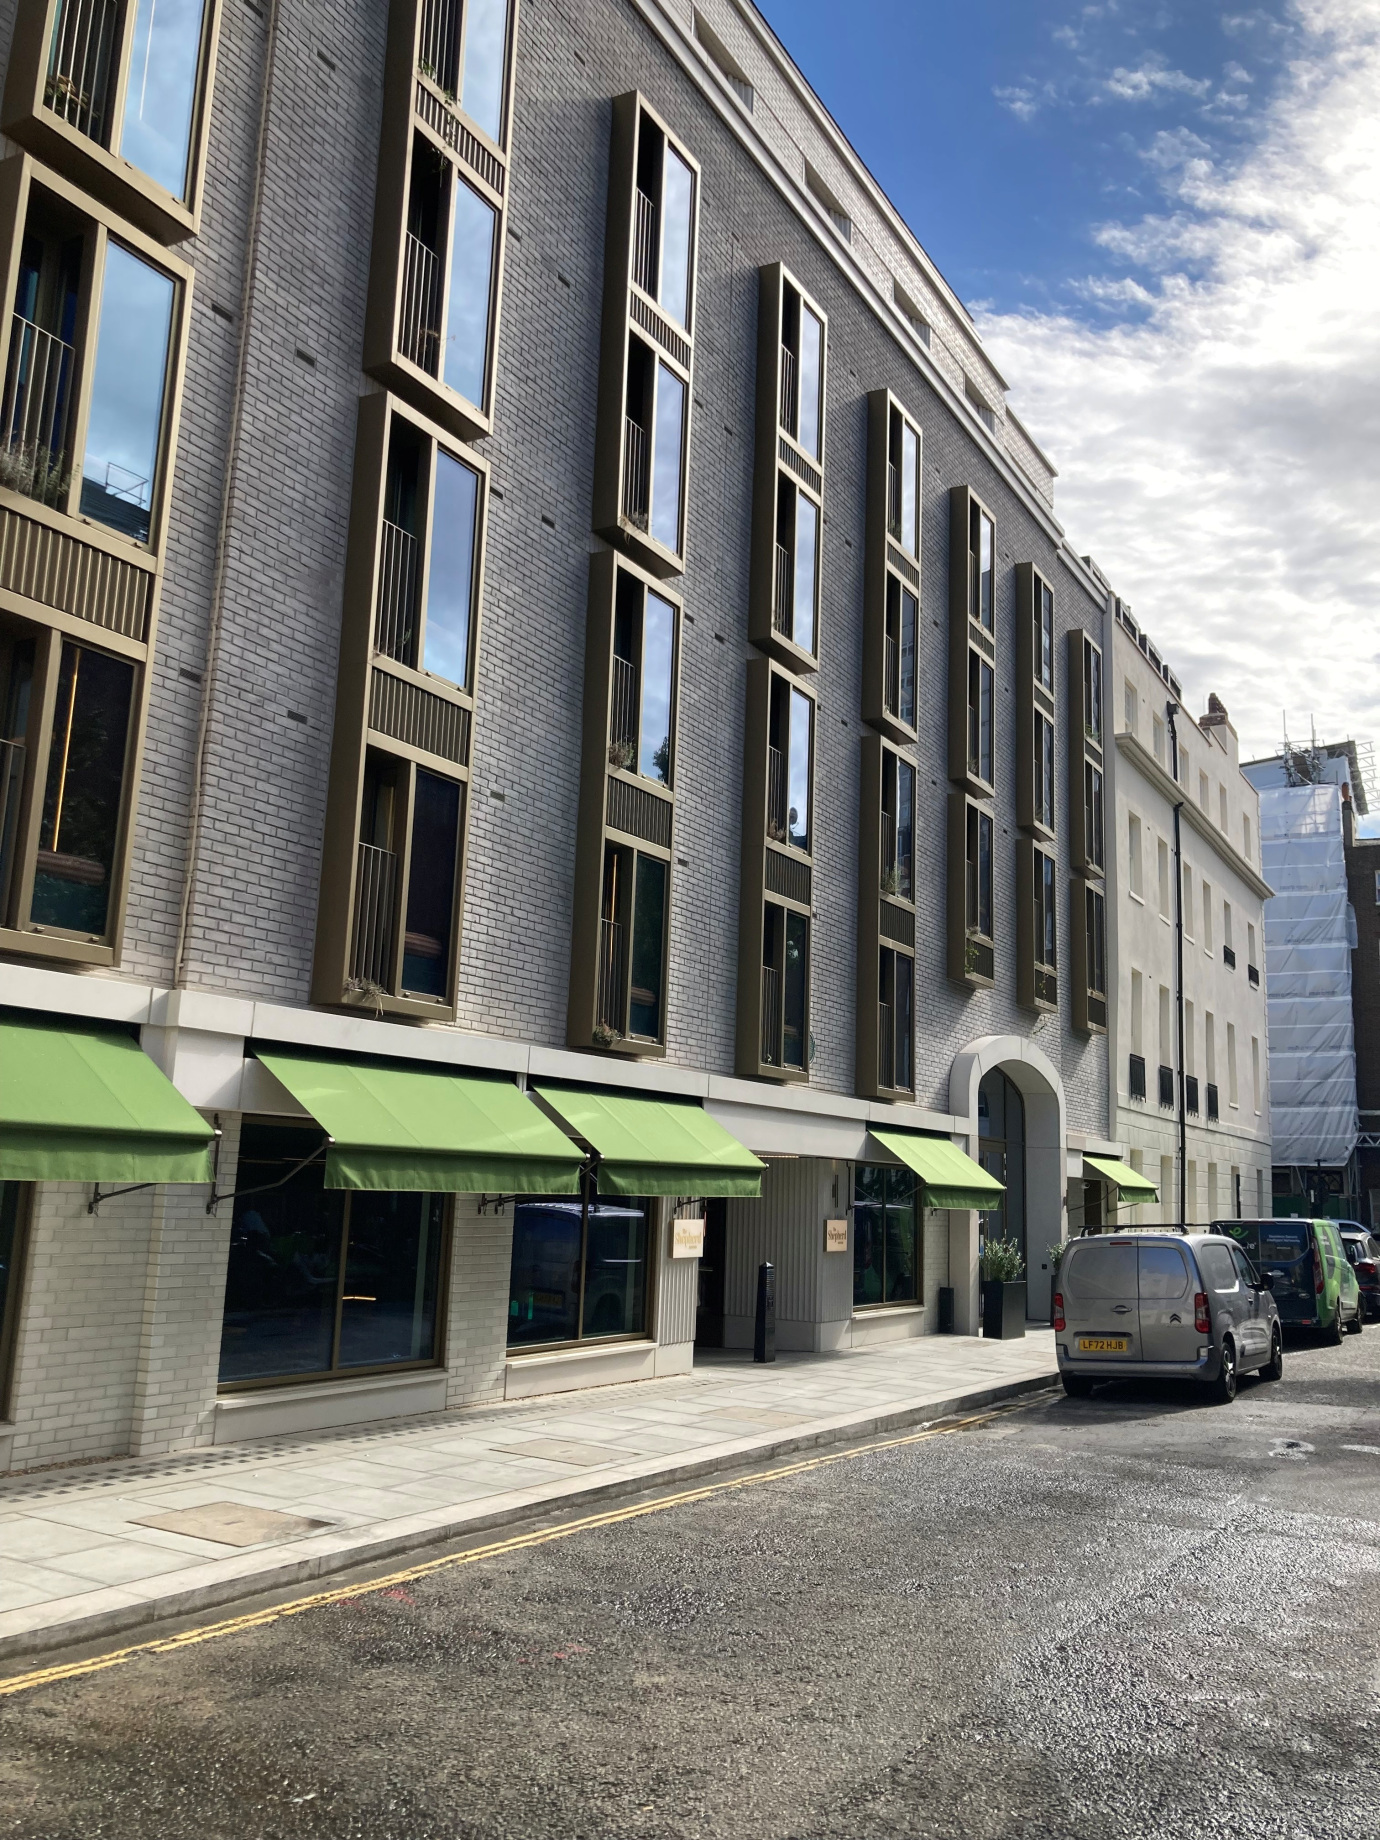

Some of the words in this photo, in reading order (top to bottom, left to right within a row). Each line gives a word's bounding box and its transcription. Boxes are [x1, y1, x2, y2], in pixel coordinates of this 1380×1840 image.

[674, 1231, 702, 1247] Shepherd
[827, 1229, 847, 1243] Shepherd
[1082, 1340, 1105, 1350] LF72
[1106, 1340, 1124, 1350] HJB
